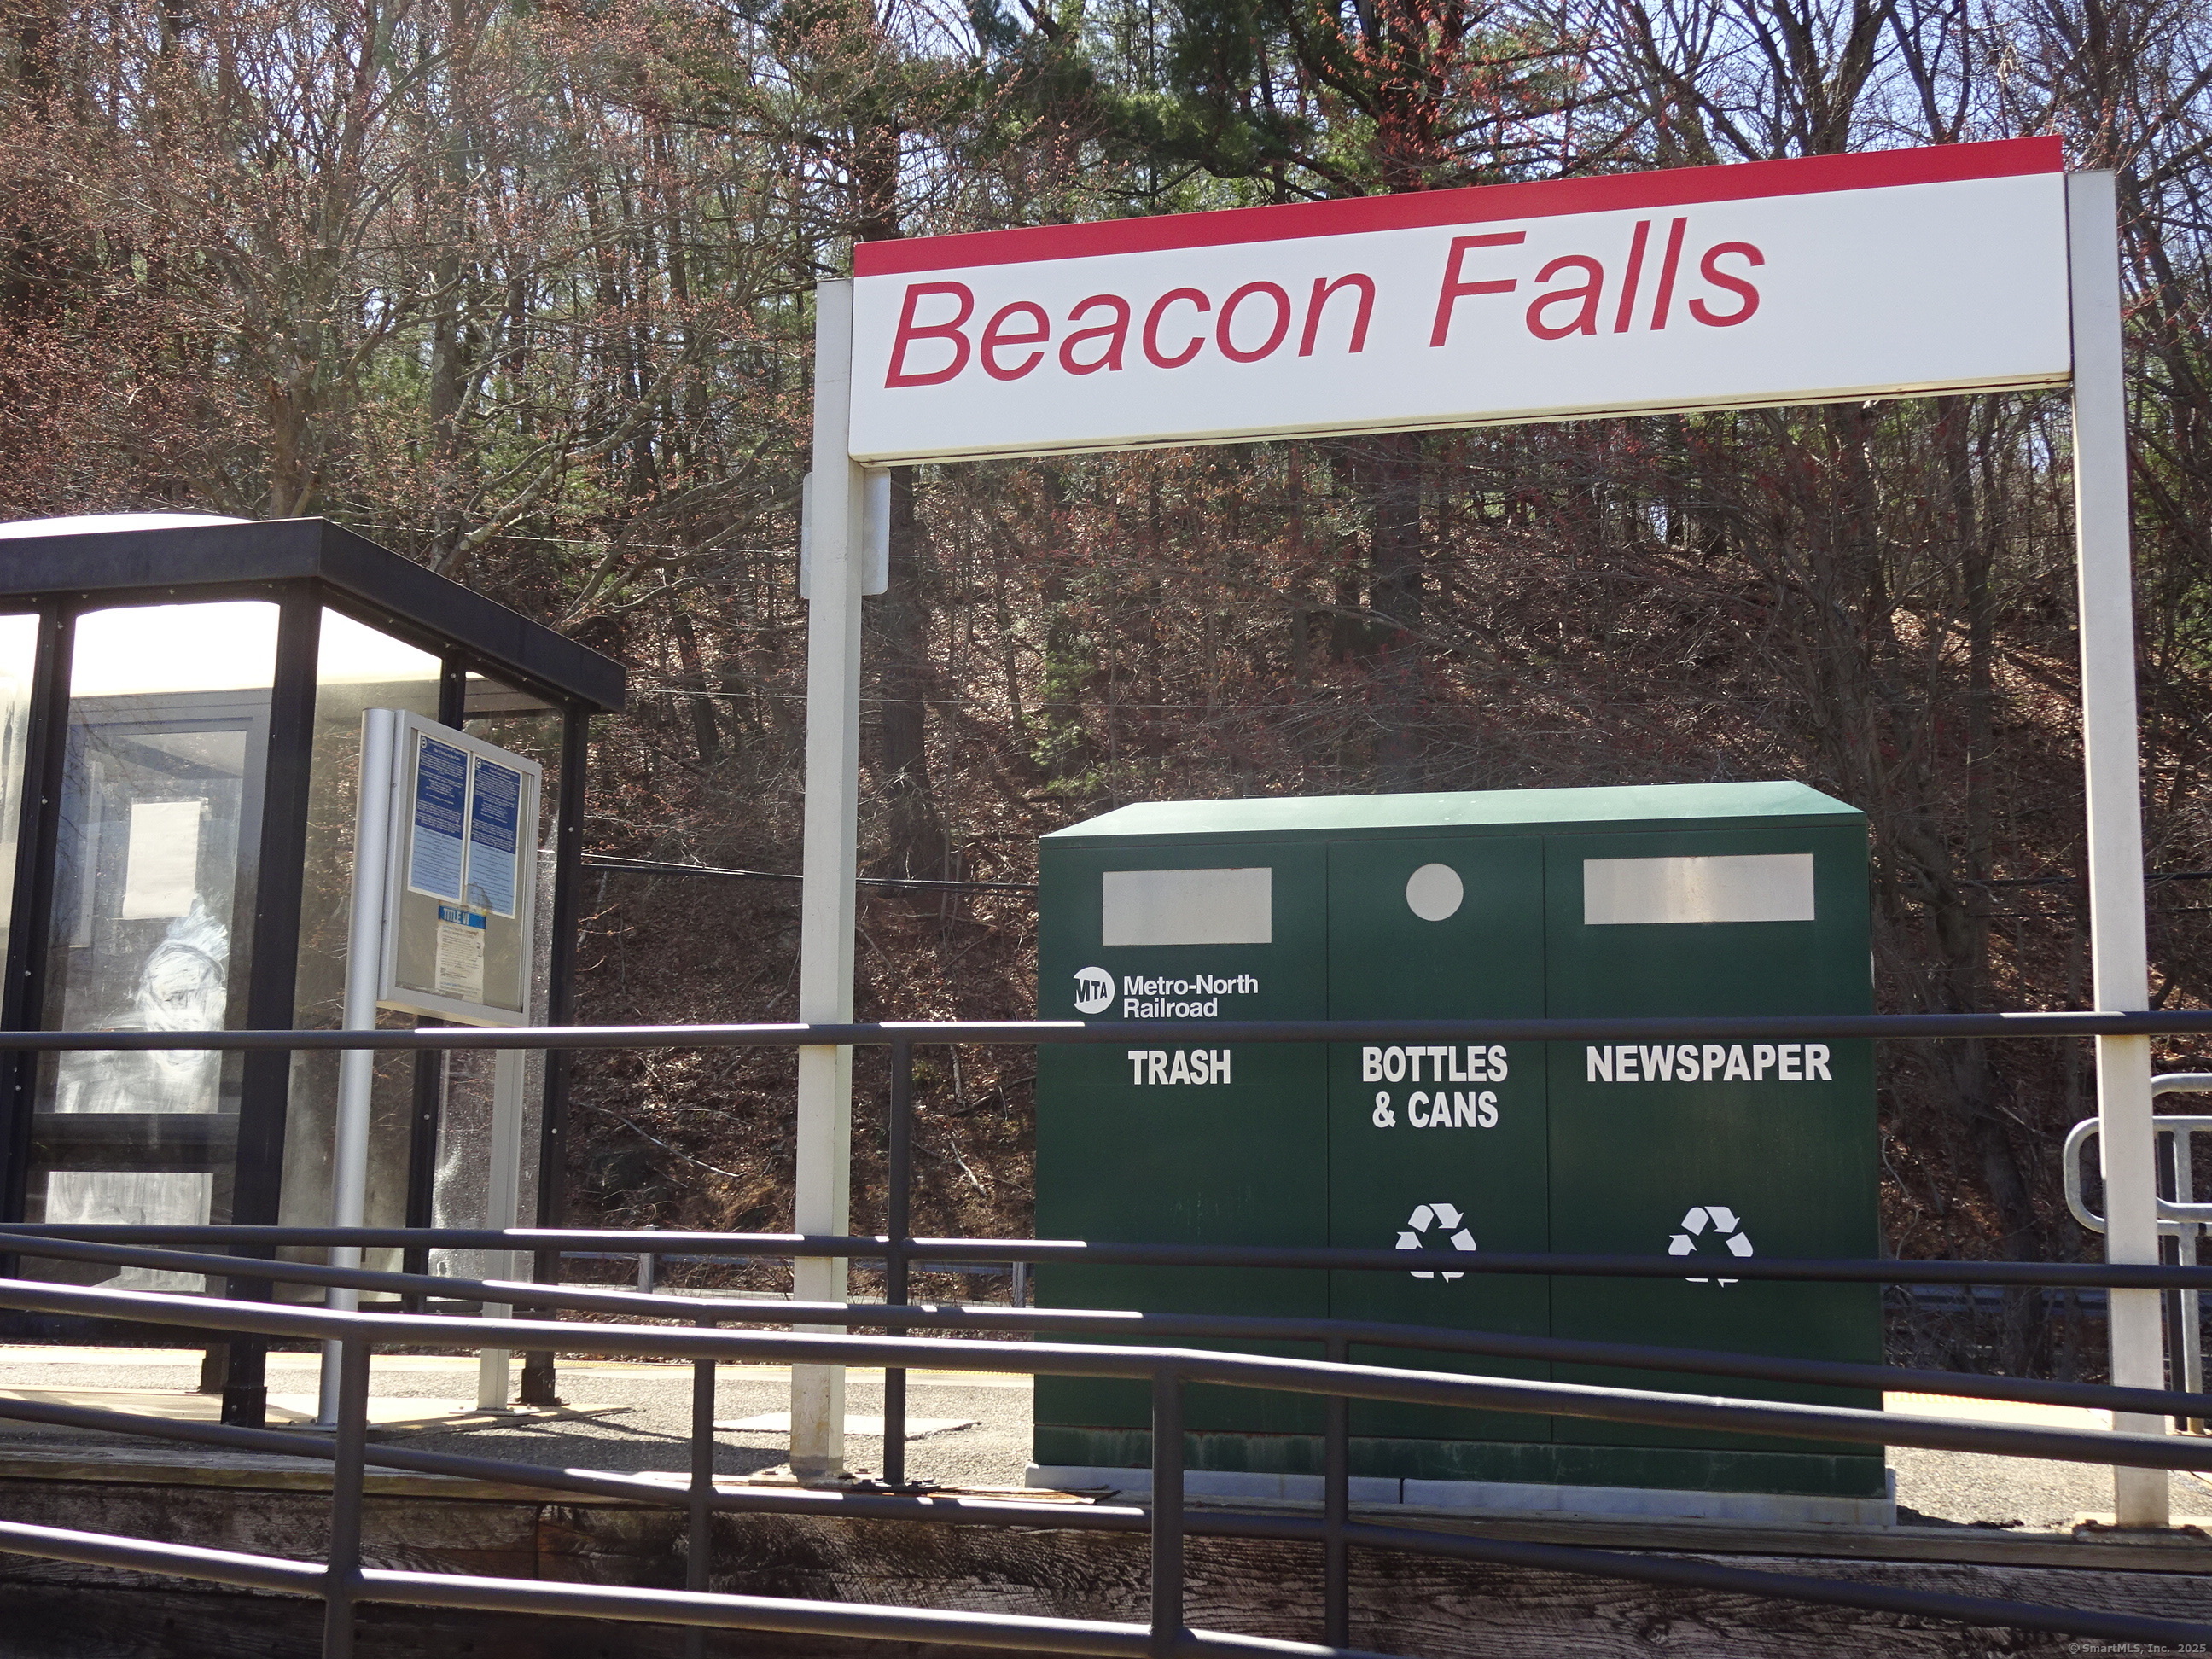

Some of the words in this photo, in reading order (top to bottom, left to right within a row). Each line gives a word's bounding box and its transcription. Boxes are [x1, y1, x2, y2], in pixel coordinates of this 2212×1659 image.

[884, 272, 1376, 388] Beacon
[1429, 217, 1765, 347] Falls
[443, 907, 461, 923] TITLE
[462, 911, 469, 926] VI
[1074, 975, 1111, 1007] MTA
[1123, 974, 1259, 996] Metro-North
[1123, 997, 1218, 1018] Railroad
[1127, 1049, 1231, 1086] TRASH
[1362, 1045, 1508, 1083] BOTTLES
[1586, 1044, 1833, 1082] NEWSPAPER
[1372, 1091, 1396, 1128] &
[1407, 1091, 1499, 1128] CANS
